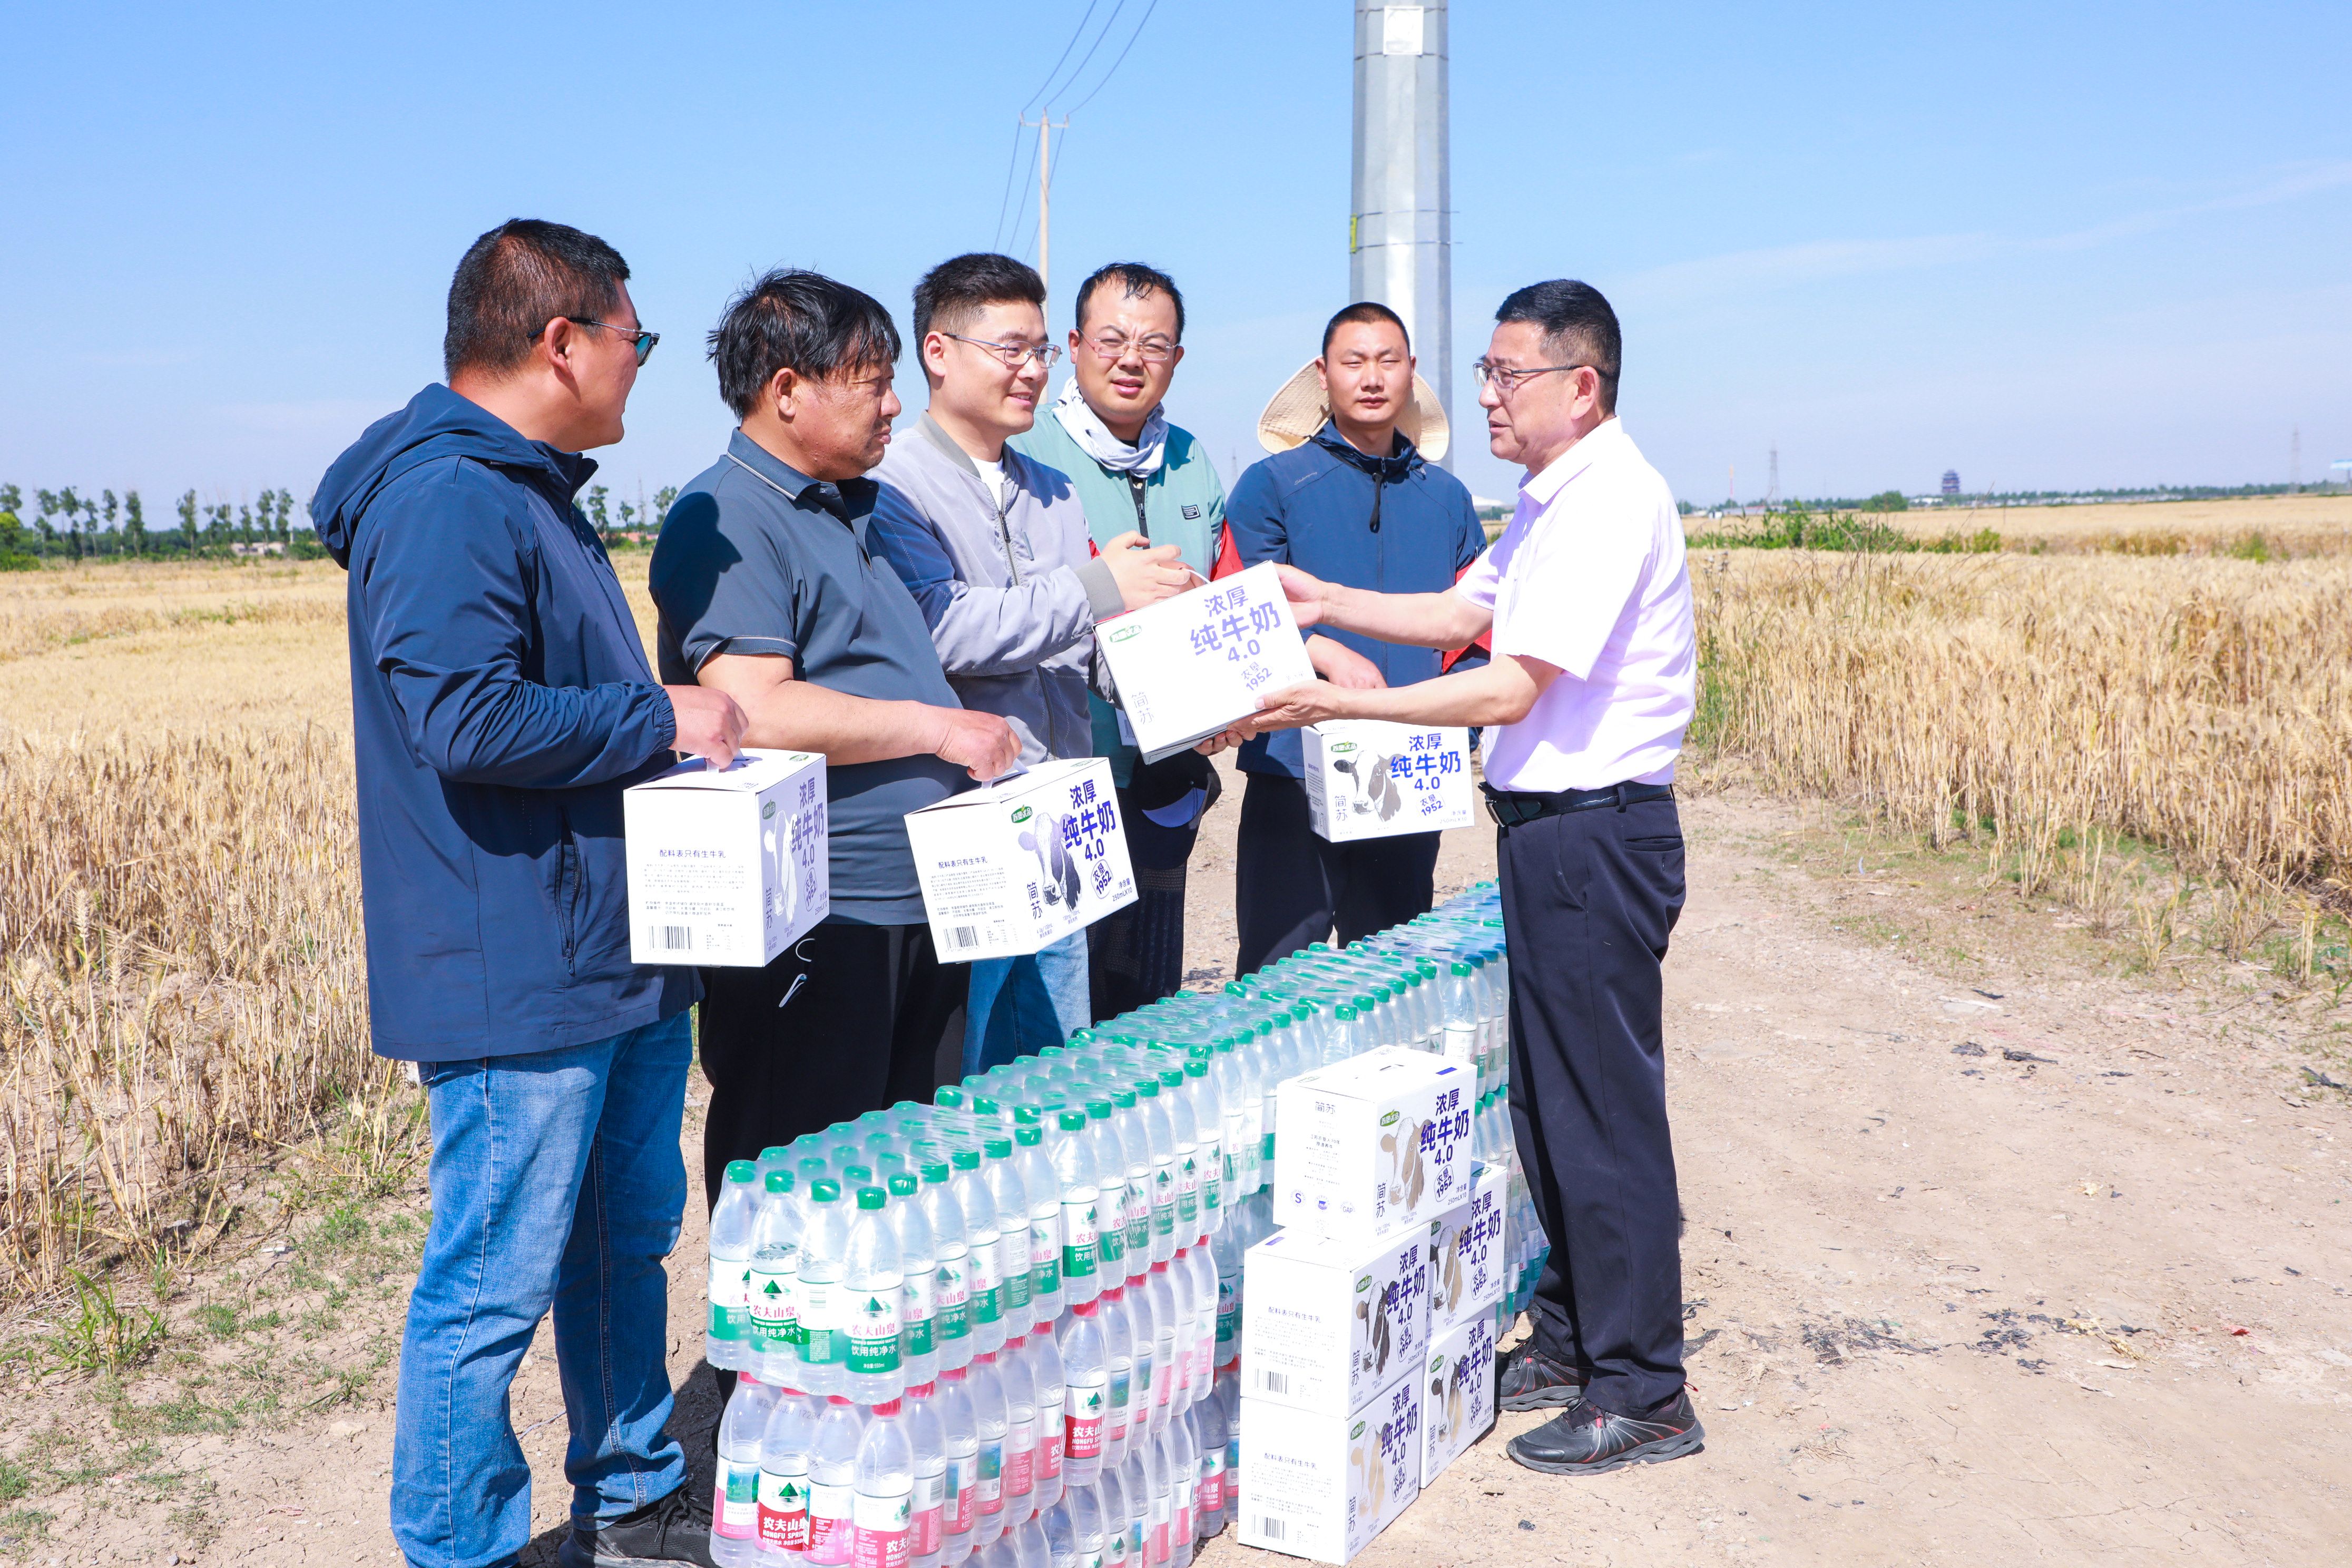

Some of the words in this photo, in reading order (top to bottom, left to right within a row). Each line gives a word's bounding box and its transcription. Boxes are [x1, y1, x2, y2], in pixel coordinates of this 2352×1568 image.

[1204, 585, 1248, 617] 浓厚
[1190, 601, 1281, 656] 纯牛奶
[1228, 639, 1261, 662] 4.0
[1246, 668, 1272, 691] 1952
[1409, 733, 1442, 751] 浓厚
[1390, 751, 1461, 779] 纯牛奶
[799, 777, 815, 809] 浓厚
[1070, 779, 1096, 810] 浓厚
[1414, 777, 1440, 791] 4.0
[1012, 808, 1033, 822] 苏垦优品
[1421, 800, 1443, 816] 1952
[791, 802, 824, 853] 纯牛奶
[1062, 800, 1116, 850] 纯牛奶
[659, 849, 726, 858] 配料表只有生牛乳
[802, 844, 815, 868] 4.0
[1085, 838, 1104, 861] 4.0
[938, 856, 987, 869] 配料表只有生牛乳
[806, 880, 816, 906] 1952
[1096, 870, 1112, 894] 1952
[1316, 1101, 1336, 1114] 简苏
[1436, 1088, 1459, 1116] 浓厚
[1420, 1109, 1469, 1154] 纯牛奶
[1435, 1144, 1453, 1165] 4.0
[1296, 1193, 1301, 1203] S
[1437, 1175, 1453, 1198] 1952
[1472, 1191, 1492, 1220] 浓厚
[1458, 1209, 1501, 1257] 纯牛奶
[1399, 1244, 1418, 1276] 浓厚
[1471, 1244, 1486, 1266] 4.0
[1387, 1264, 1425, 1315] 纯牛奶
[1473, 1273, 1486, 1296] 1952
[753, 1305, 795, 1318] 农夫山泉
[1398, 1302, 1412, 1325] 4.0
[752, 1326, 795, 1338] 饮用纯净水
[852, 1323, 895, 1336] 农夫山泉
[1468, 1318, 1485, 1350] 浓厚
[851, 1344, 896, 1356] 饮用纯净水
[1399, 1334, 1412, 1358] 1952
[1459, 1335, 1492, 1388] 纯牛奶
[1469, 1373, 1482, 1395] 4.0
[1392, 1384, 1410, 1417] 浓厚
[1470, 1400, 1482, 1425] 1952
[1381, 1403, 1417, 1458] 纯牛奶
[1392, 1442, 1406, 1466] 4.0
[1394, 1473, 1405, 1498] 1952
[763, 1530, 785, 1539] NONGFU
[886, 1552, 906, 1561] NONGFU
